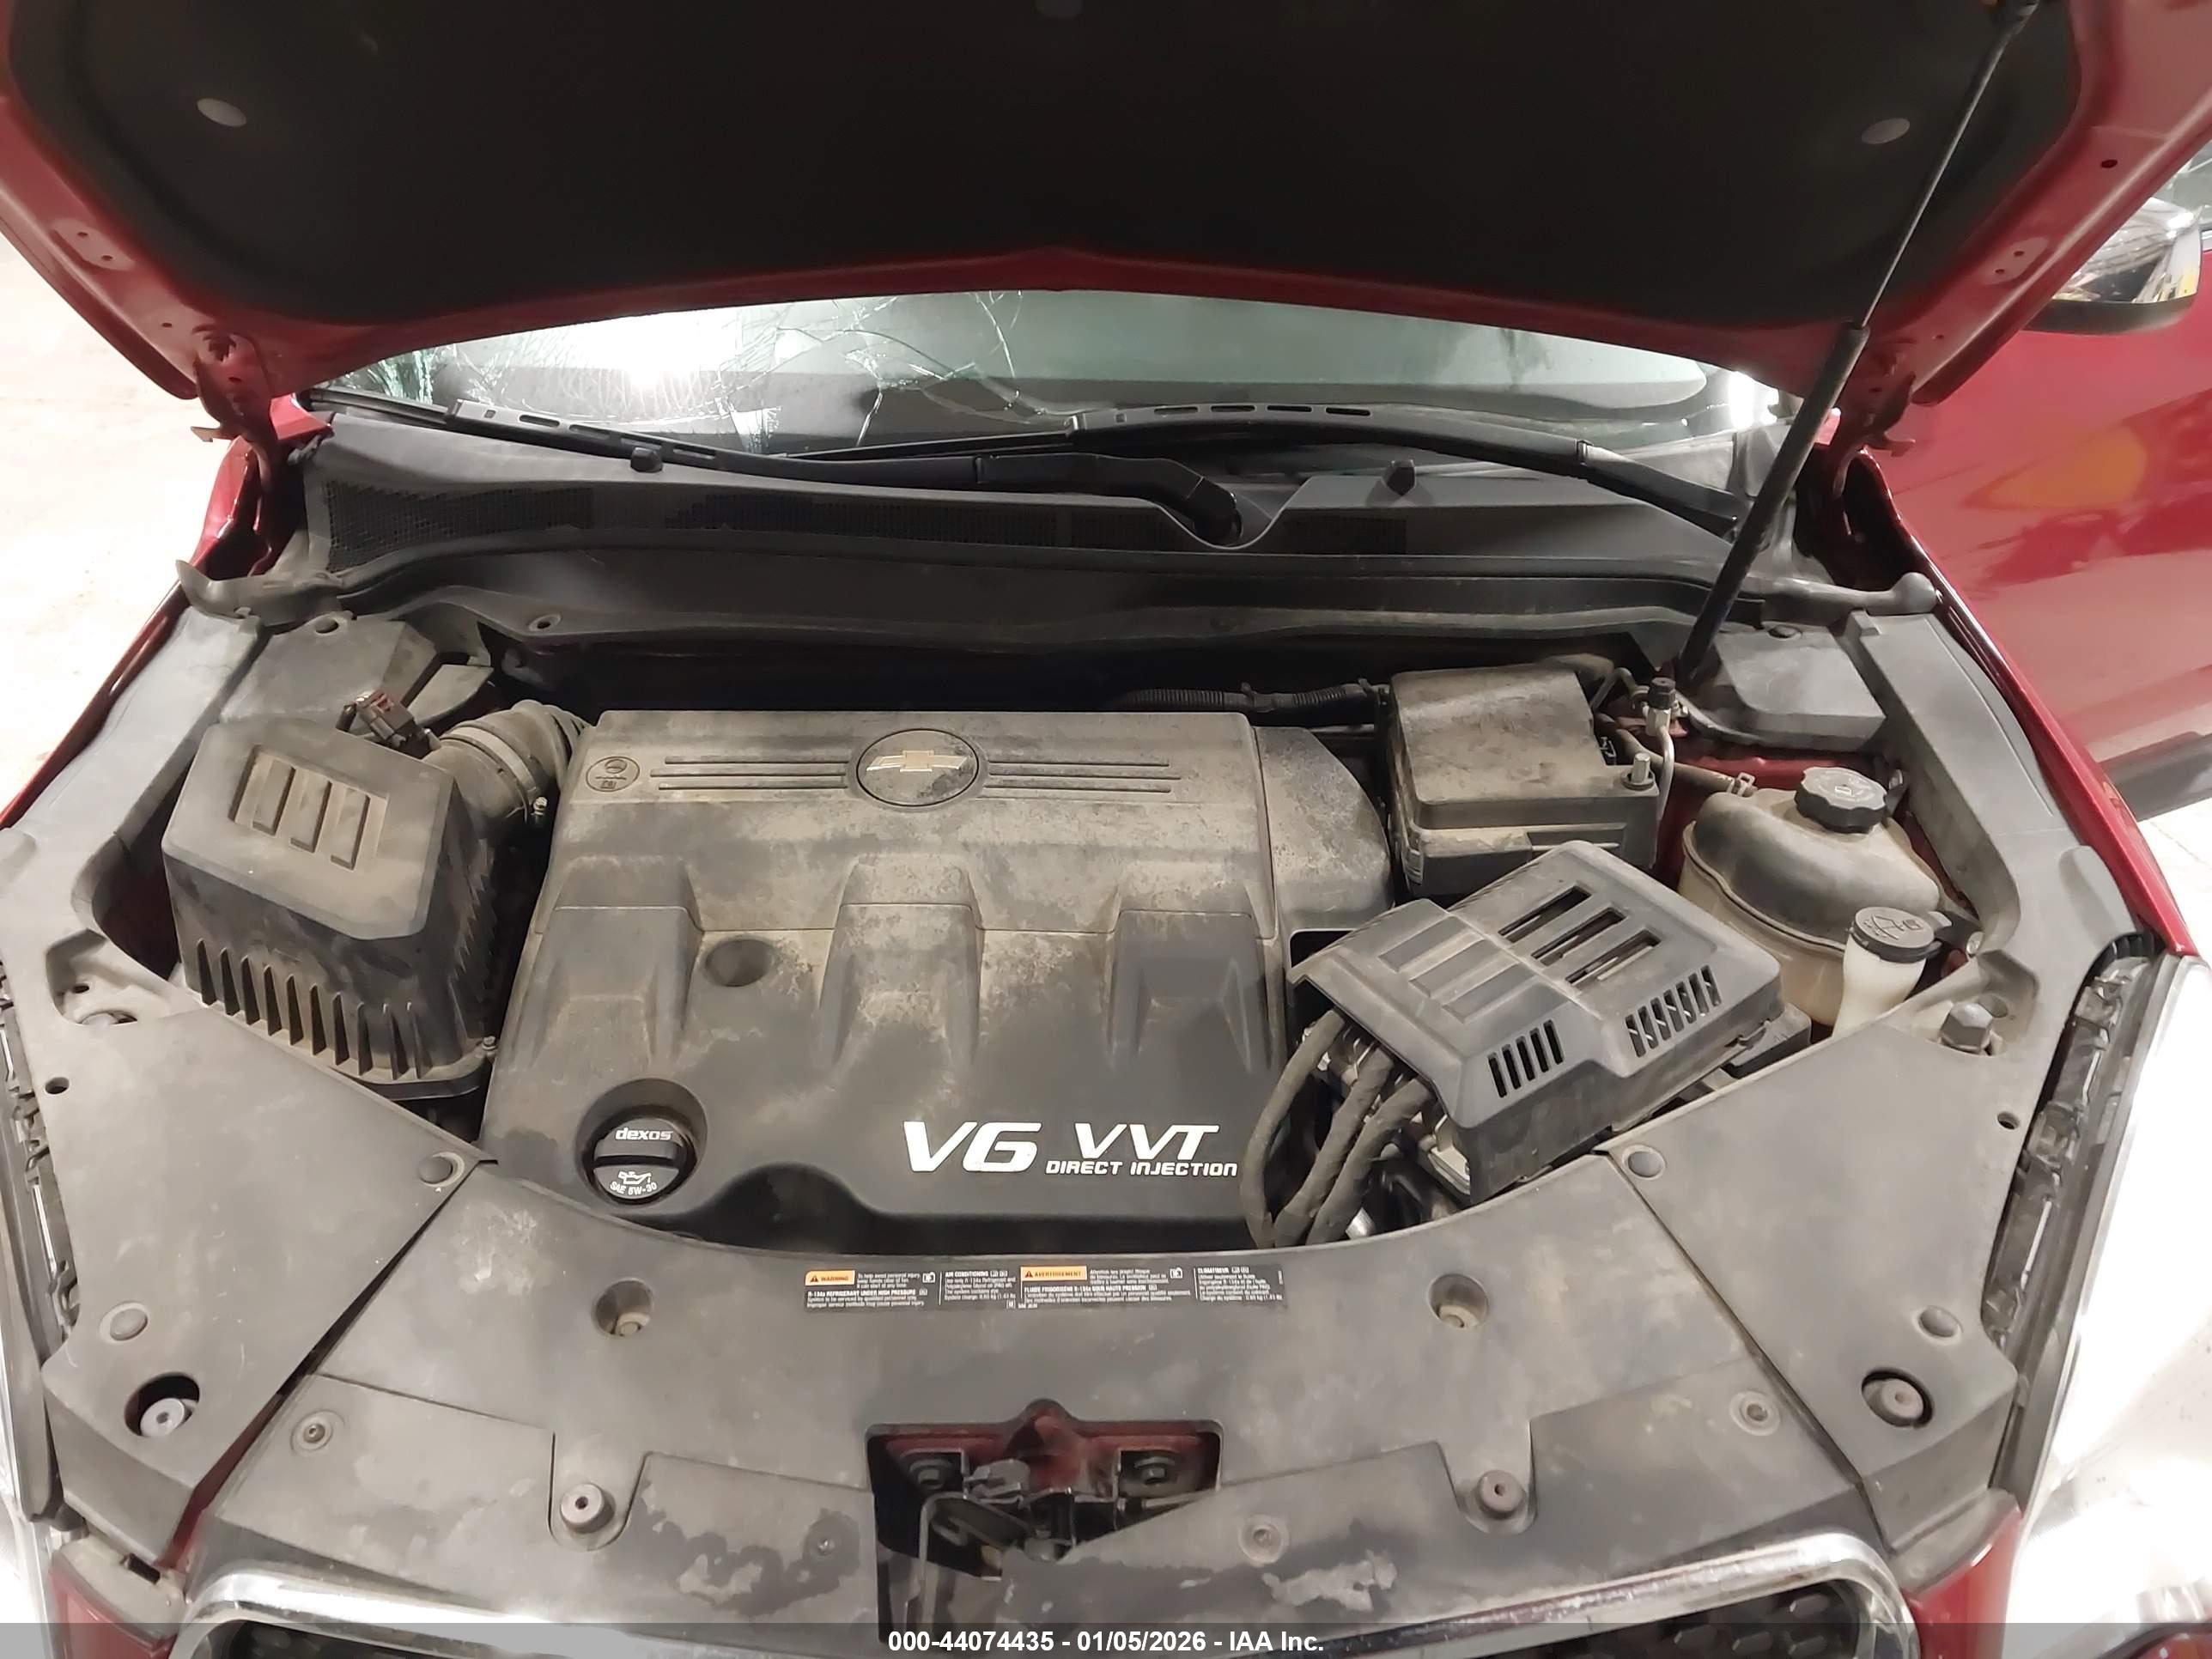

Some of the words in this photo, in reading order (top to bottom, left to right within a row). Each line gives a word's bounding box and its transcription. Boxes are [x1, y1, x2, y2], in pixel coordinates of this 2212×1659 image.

[615, 1127, 674, 1141] dexos
[903, 1121, 1042, 1172] V6
[1074, 1122, 1219, 1161] VVT
[1045, 1160, 1122, 1175] DIRECT
[1130, 1162, 1237, 1176] INJECTION
[610, 1181, 627, 1194] SAE
[628, 1182, 658, 1195] 5W-30
